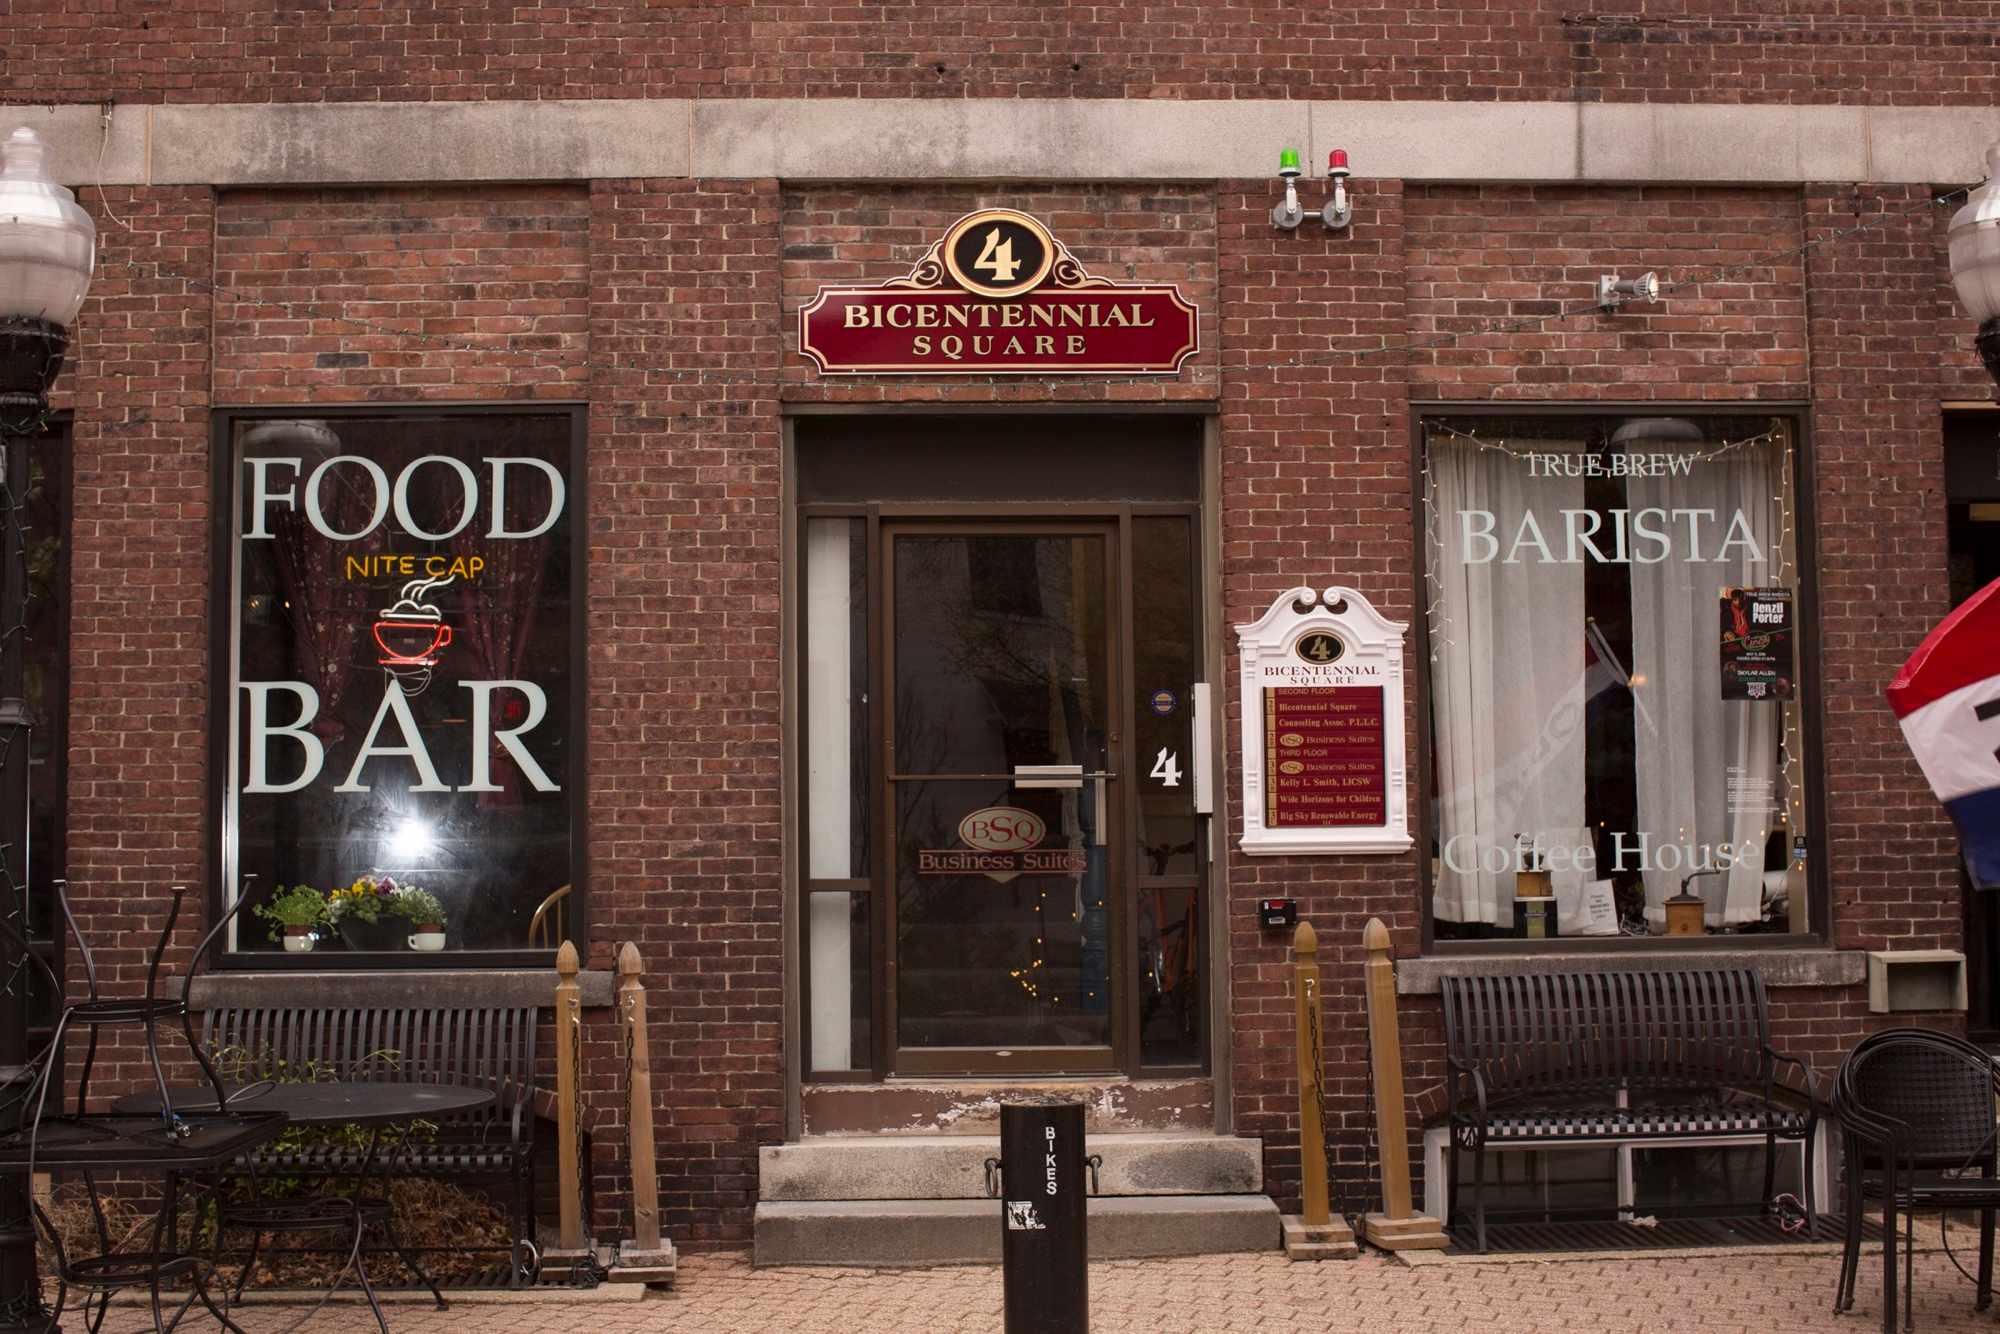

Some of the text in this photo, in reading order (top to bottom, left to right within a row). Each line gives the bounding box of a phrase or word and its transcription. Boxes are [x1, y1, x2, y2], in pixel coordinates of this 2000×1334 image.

[974, 227, 1021, 281] 4
[843, 304, 1154, 328] BICENTENNIAL
[912, 336, 1087, 359] SQUARE
[1523, 453, 1696, 477] TRUE BREW
[241, 455, 566, 541] FOOD
[1456, 508, 1768, 564] BARISTA
[346, 556, 485, 580] NITE CAP
[1752, 602, 1783, 613] Denzil
[1752, 613, 1784, 623] Porter
[1310, 636, 1331, 660] 4
[1264, 666, 1380, 676] BICENTENNIAL
[1290, 676, 1355, 686] SQUARE
[1279, 687, 1336, 695] SECOND FLOOR
[1279, 703, 1327, 712] Bicentennial
[1330, 704, 1357, 713] Square
[239, 679, 561, 793] BAR
[1307, 736, 1345, 744] Business
[1303, 749, 1328, 757] FLOOR
[1150, 747, 1183, 786] 4
[1307, 763, 1346, 771] Business
[1280, 778, 1300, 788] Kelly
[1303, 778, 1311, 786] L.
[1313, 778, 1340, 787] Smith,
[1280, 793, 1381, 803] Wide Horizons for Children
[1280, 811, 1293, 821] Big
[1295, 811, 1308, 821] Sky
[1311, 811, 1350, 820] Renewable
[1351, 811, 1377, 821] Energy
[971, 816, 1036, 848] BSQ
[919, 852, 1087, 870] Business Suites
[1444, 831, 1596, 875] Coffee
[1610, 831, 1762, 873] House
[1045, 1126, 1057, 1195] BIKES
